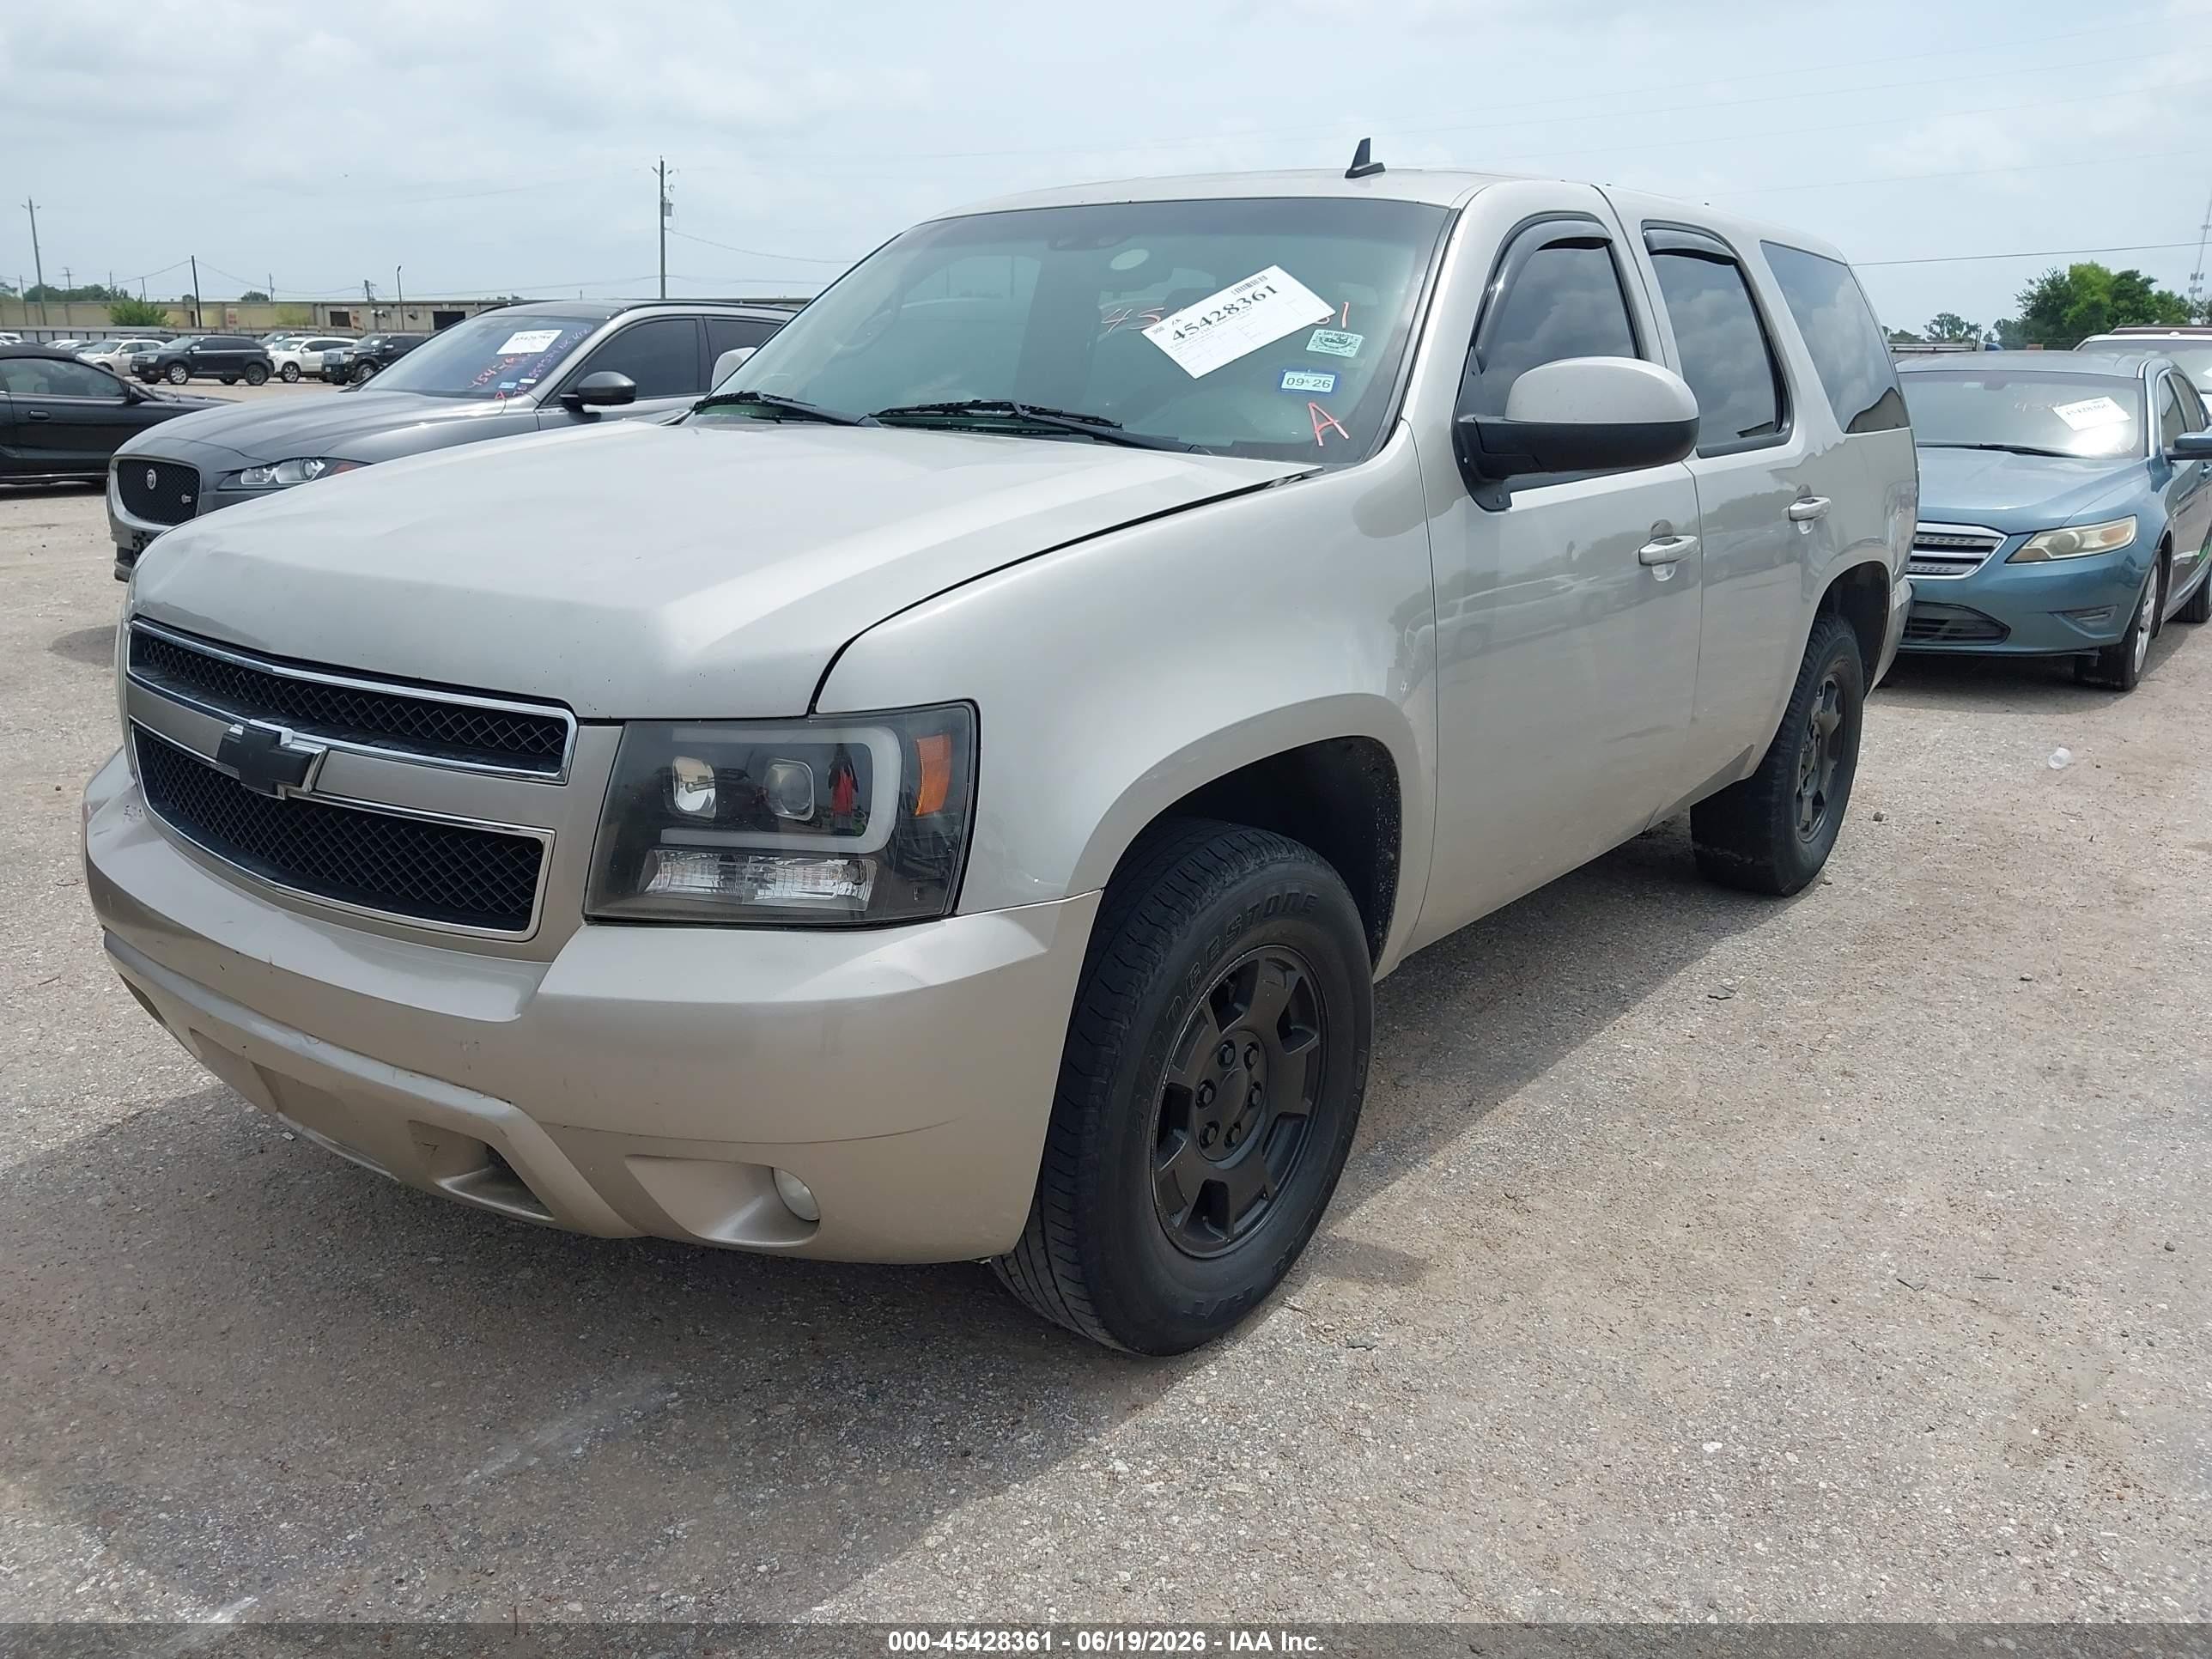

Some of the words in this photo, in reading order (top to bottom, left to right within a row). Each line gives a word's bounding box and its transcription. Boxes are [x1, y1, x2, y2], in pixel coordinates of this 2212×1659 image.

[1173, 285, 1279, 342] 45428361
[1285, 377, 1305, 386] 09
[1312, 379, 1332, 389] 26
[1307, 402, 1350, 447] A
[1132, 890, 1320, 1142] BRIDGESTONE
